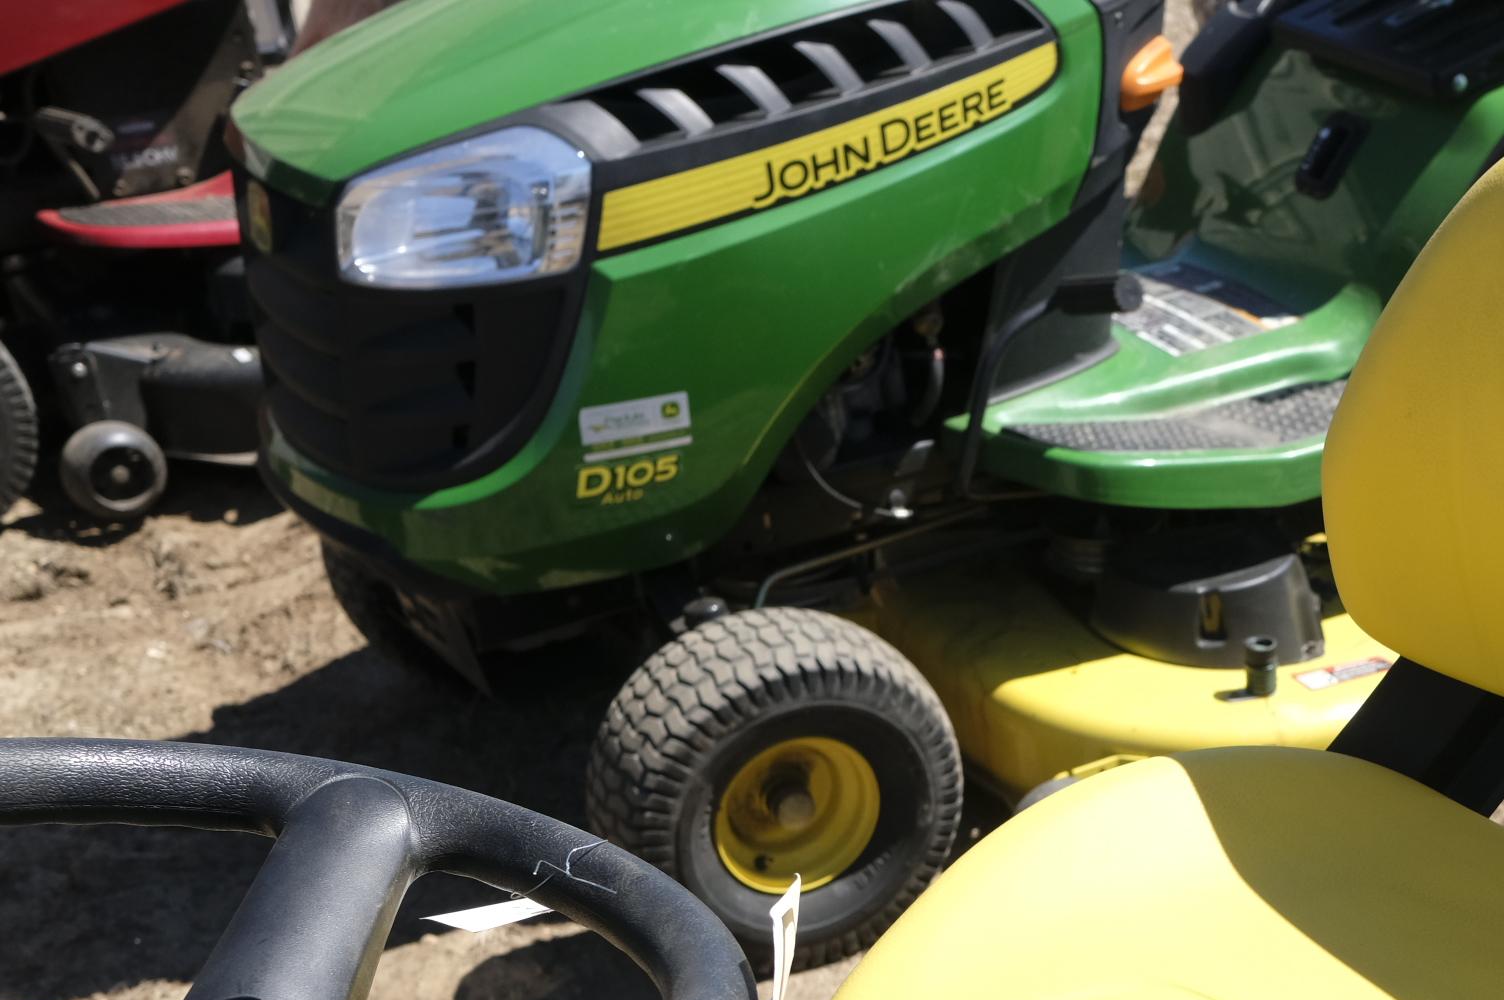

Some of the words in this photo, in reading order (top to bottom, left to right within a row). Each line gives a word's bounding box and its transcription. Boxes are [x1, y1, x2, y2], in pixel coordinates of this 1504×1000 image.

[755, 136, 872, 201] JOHN
[880, 79, 1008, 155] DEERE
[576, 454, 680, 500] D105
